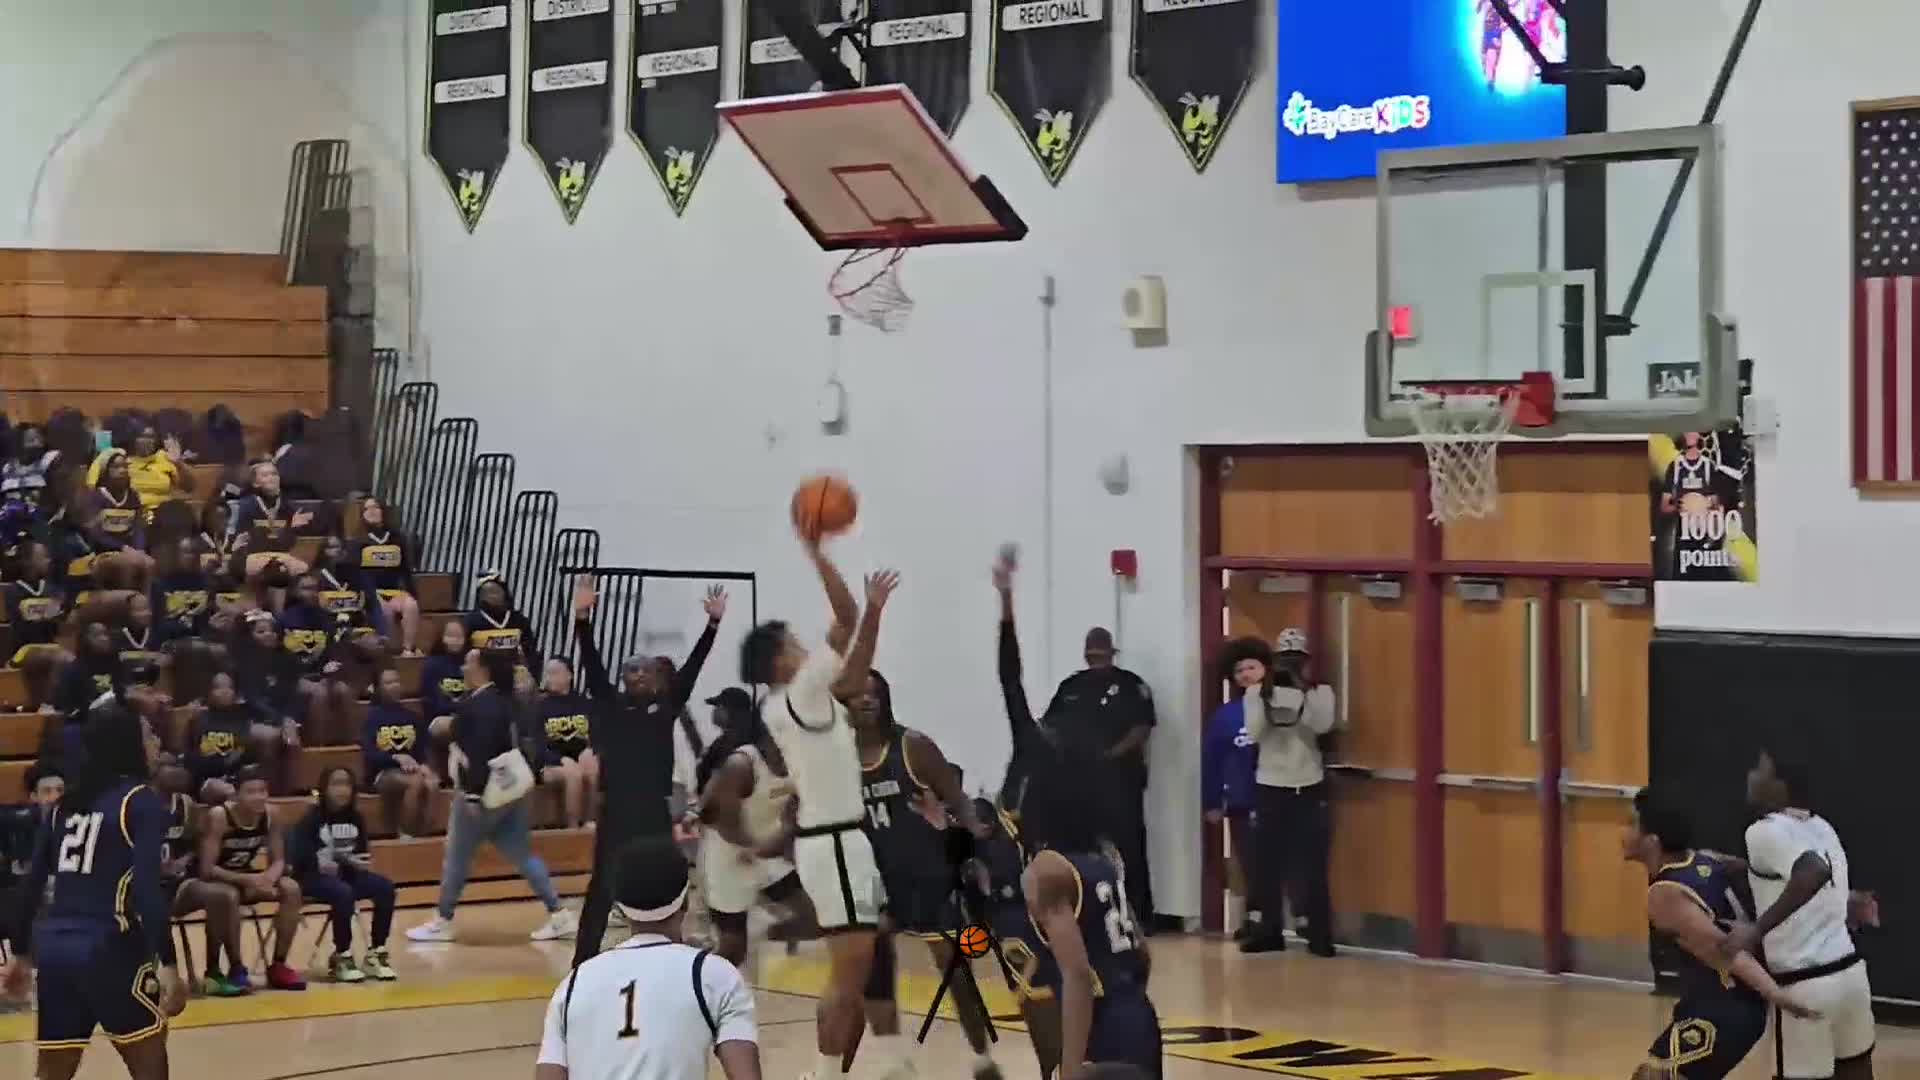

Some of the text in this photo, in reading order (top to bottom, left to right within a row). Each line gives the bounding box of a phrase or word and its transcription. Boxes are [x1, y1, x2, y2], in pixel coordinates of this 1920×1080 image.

[888, 19, 951, 41] REGIONAL
[1020, 6, 1089, 25] REGIONAL
[1307, 106, 1373, 139] BayCare
[1680, 508, 1742, 541] 1000
[57, 812, 104, 875] 21
[617, 979, 639, 1040] 1
